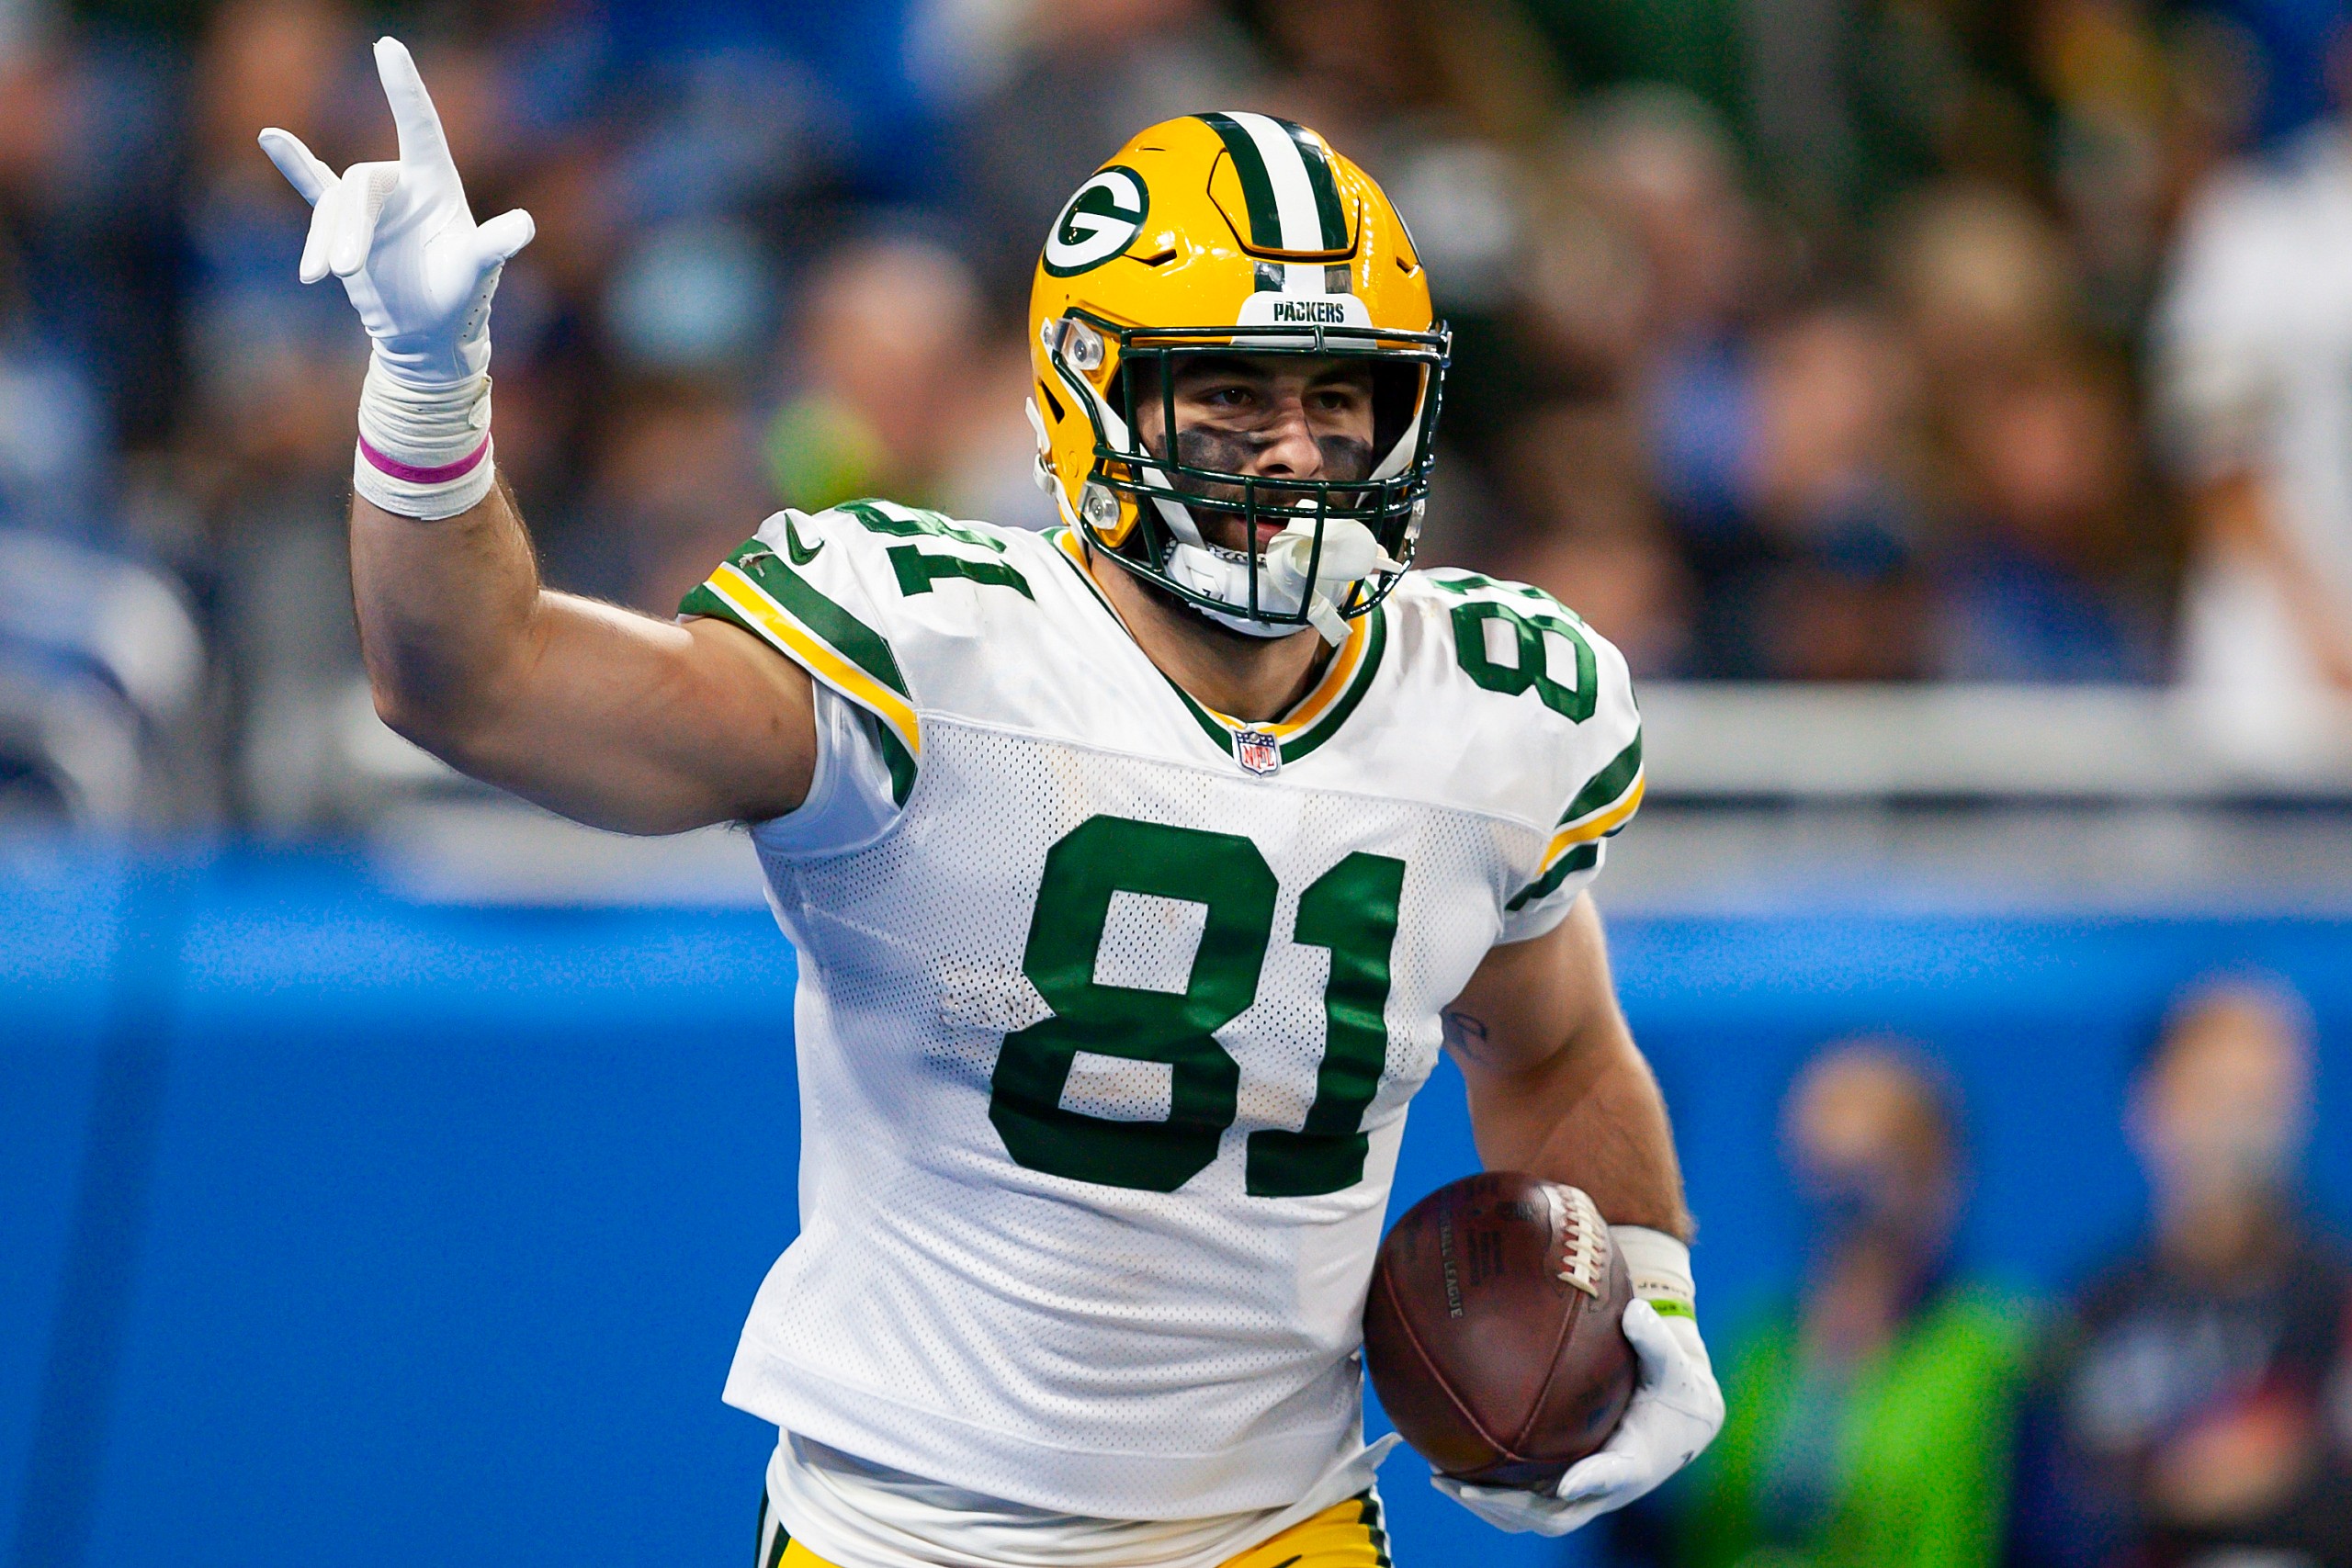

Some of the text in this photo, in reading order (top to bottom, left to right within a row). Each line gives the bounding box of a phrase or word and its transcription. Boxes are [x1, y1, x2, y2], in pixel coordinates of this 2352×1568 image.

[1046, 171, 1140, 267] G
[1273, 300, 1344, 323] PACKERS
[1242, 744, 1275, 770] NFL
[988, 813, 1406, 1197] 81
[1443, 1259, 1464, 1319] LEAGUE
